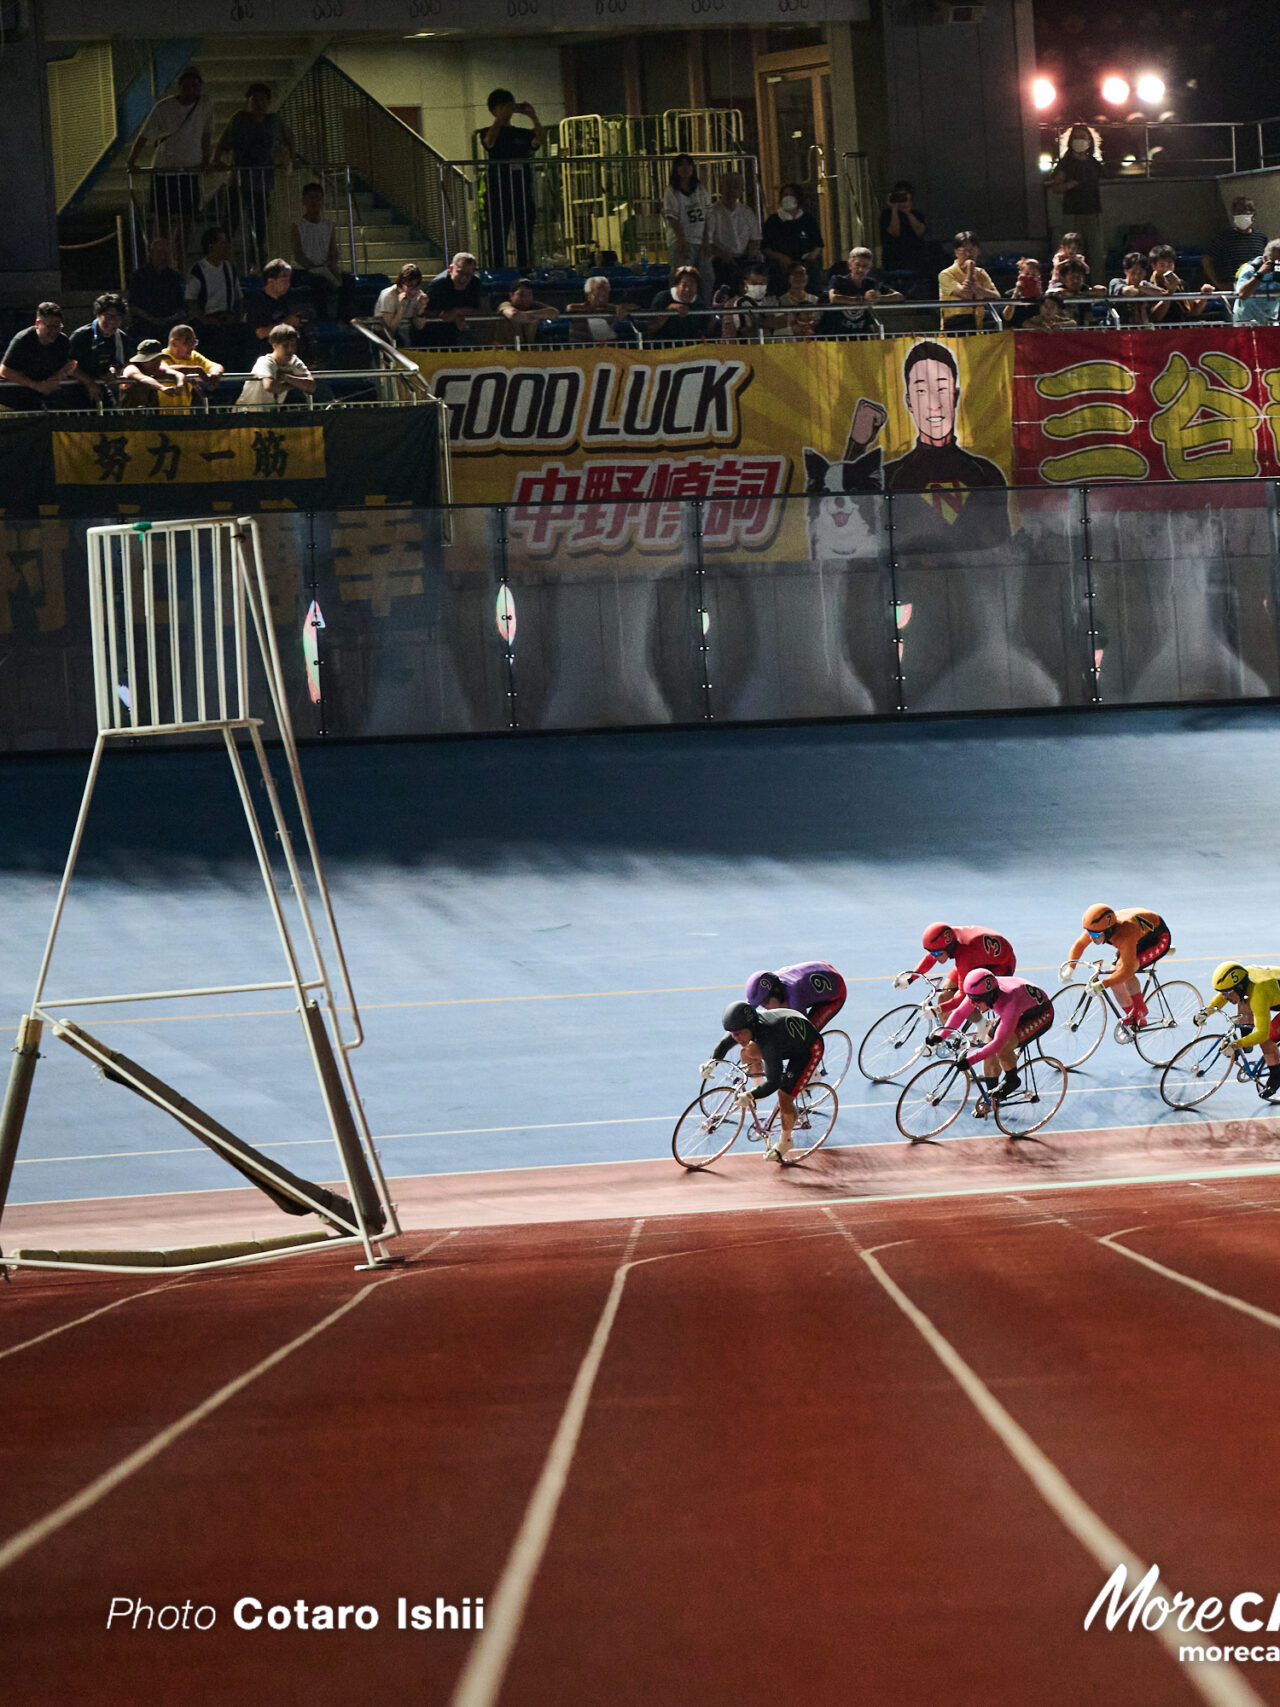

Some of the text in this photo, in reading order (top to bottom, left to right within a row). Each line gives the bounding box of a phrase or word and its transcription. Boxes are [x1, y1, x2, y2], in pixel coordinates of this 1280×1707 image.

[686, 207, 706, 224] 52
[432, 364, 741, 442] GOOD LUCK
[92, 428, 290, 483] 努力一筋
[512, 457, 784, 544] 中野慎詞
[1134, 914, 1155, 933] 7
[982, 933, 1002, 957] 3
[809, 972, 833, 994] 9
[985, 977, 994, 992] 8
[1229, 969, 1241, 985] 5
[1024, 983, 1045, 1006] 8
